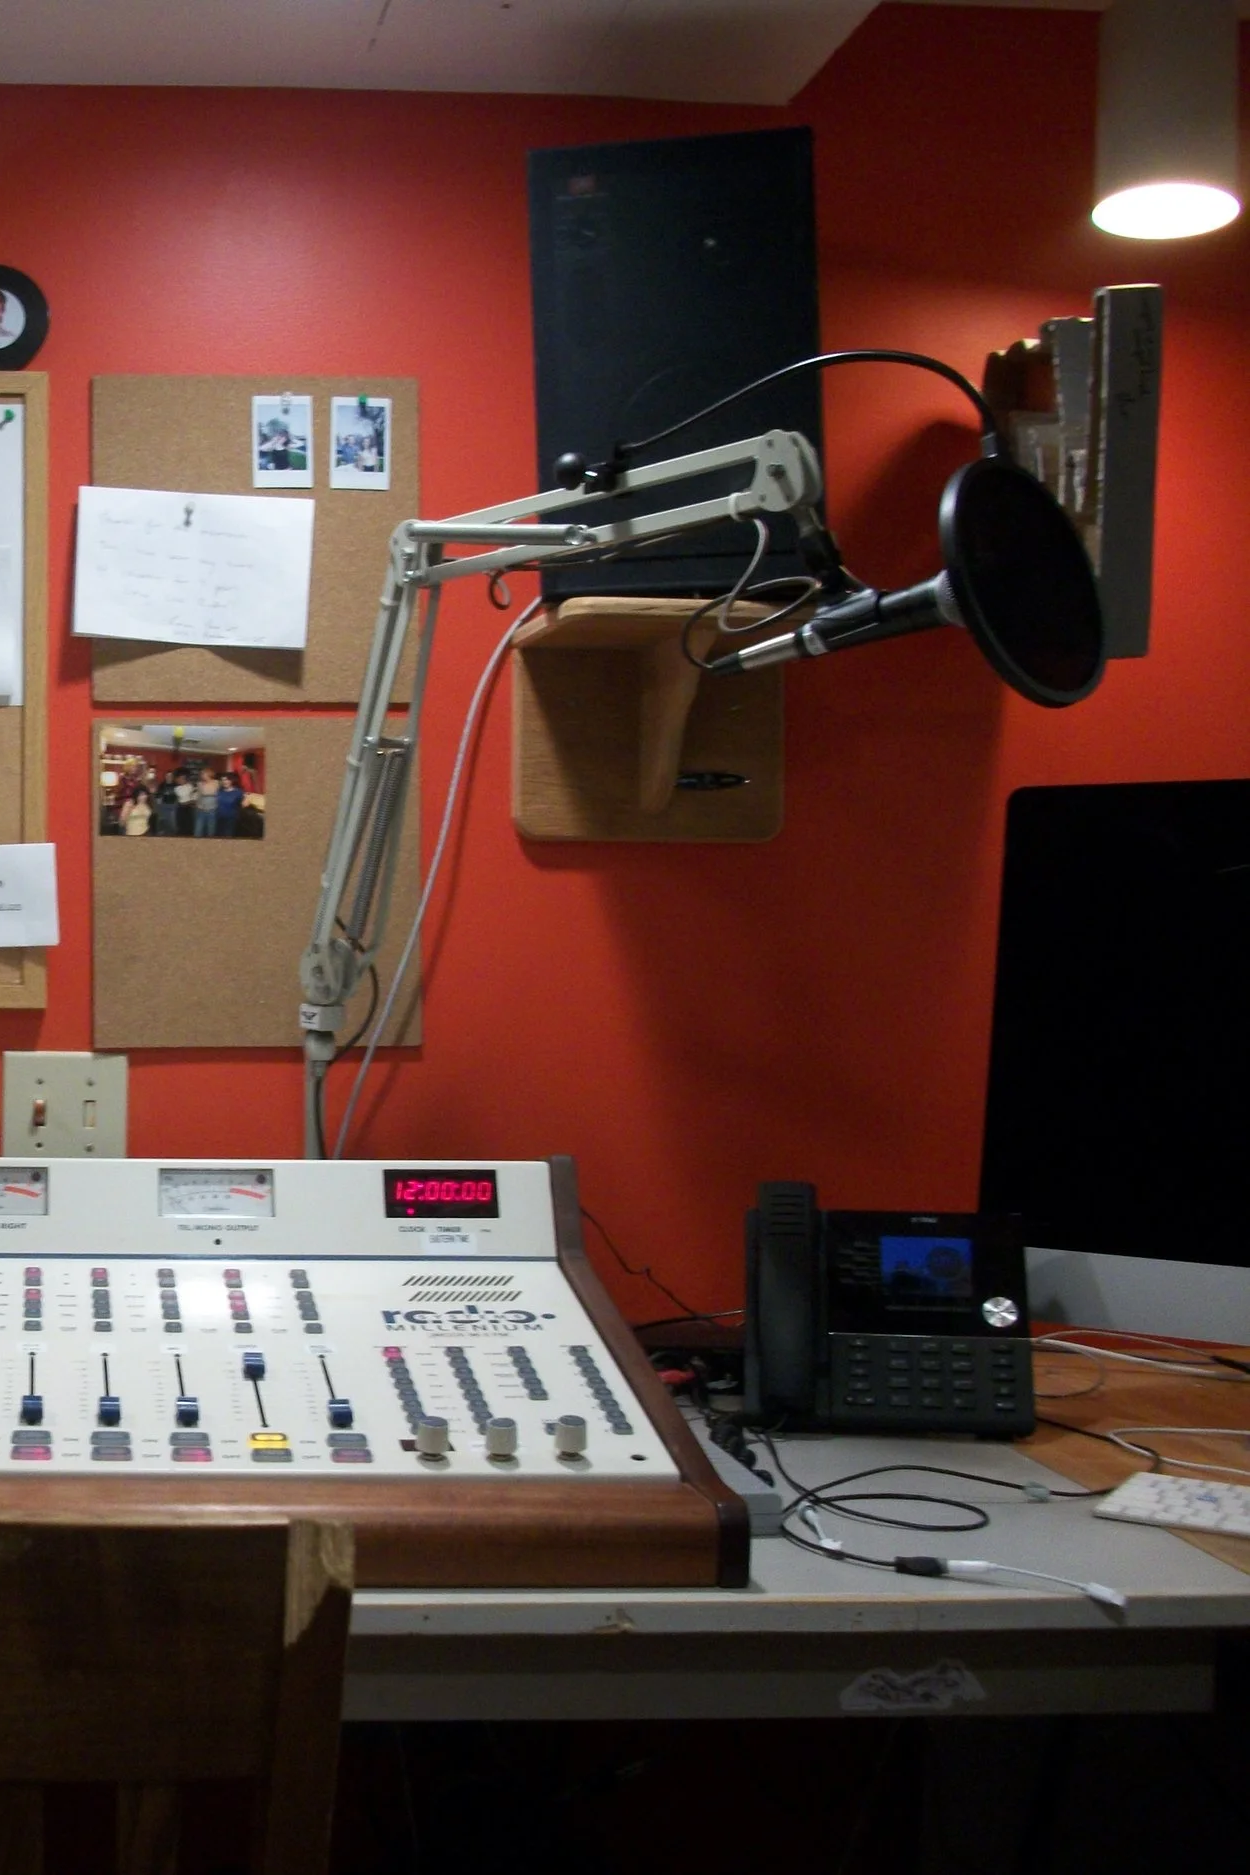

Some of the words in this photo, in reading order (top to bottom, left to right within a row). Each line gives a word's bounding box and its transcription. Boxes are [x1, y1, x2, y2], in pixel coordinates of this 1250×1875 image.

[395, 1181, 492, 1201] 12:00:00
[381, 1305, 537, 1324] radio
[385, 1323, 544, 1332] MILLENIUM
